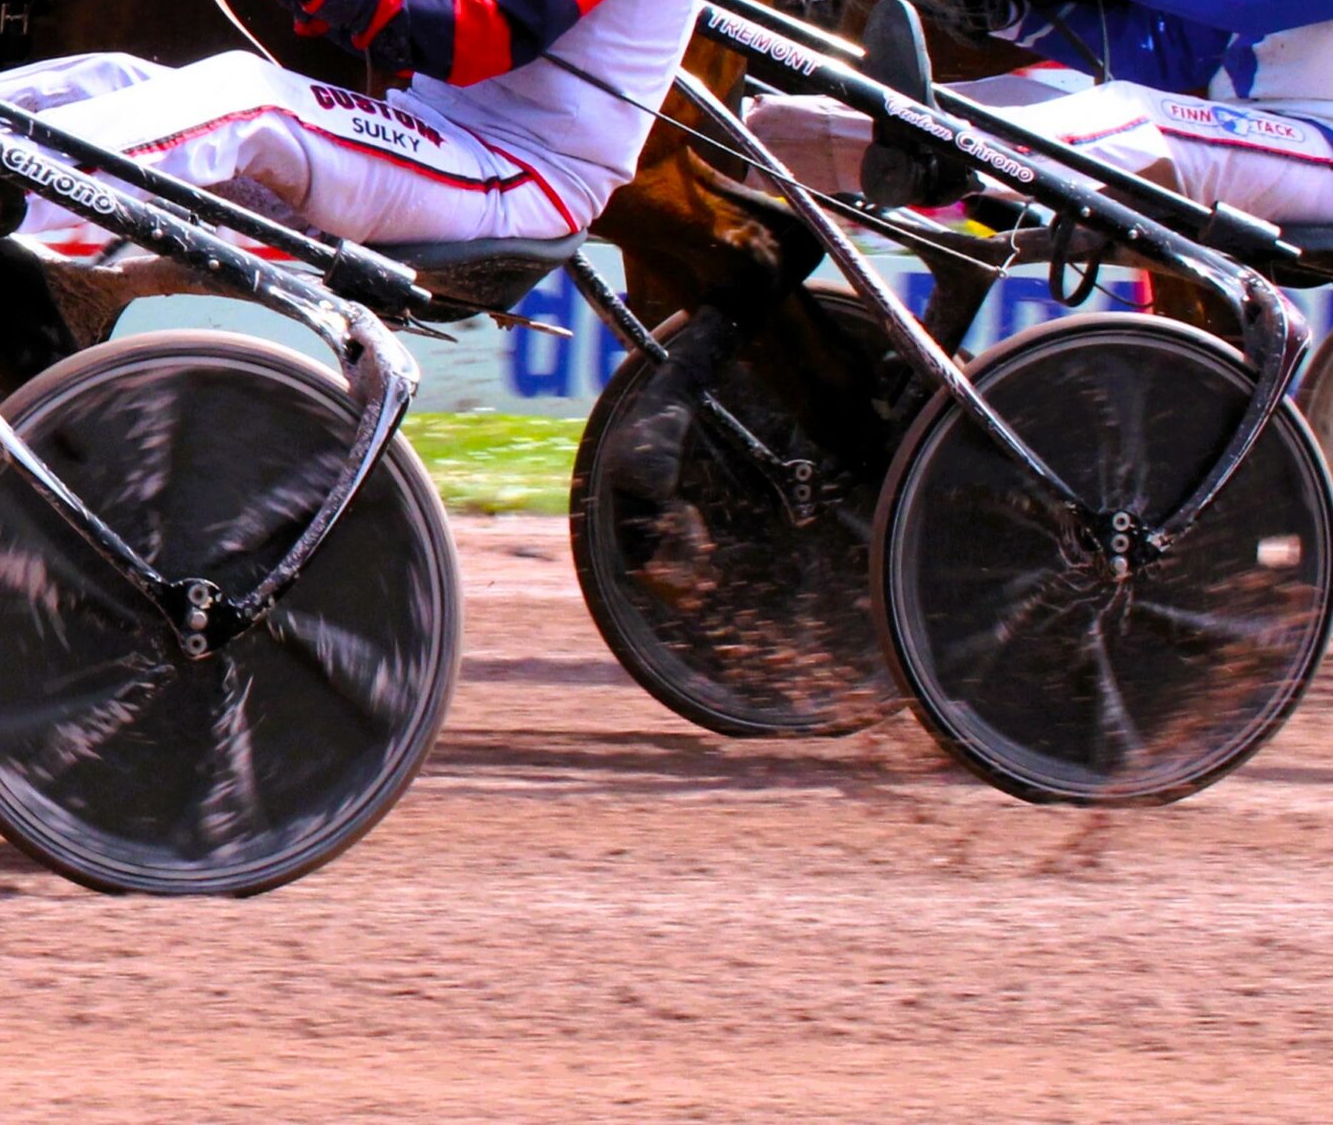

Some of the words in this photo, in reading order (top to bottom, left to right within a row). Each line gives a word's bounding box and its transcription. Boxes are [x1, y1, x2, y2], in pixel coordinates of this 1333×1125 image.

[707, 8, 821, 77] TREMONT
[309, 83, 448, 150] CUSTOM
[352, 116, 421, 153] SULKY
[884, 94, 953, 143] Custom
[955, 130, 1035, 183] Chrono
[1170, 104, 1213, 123] FINN
[1255, 118, 1297, 138] TACK
[1, 142, 118, 215] Chrono
